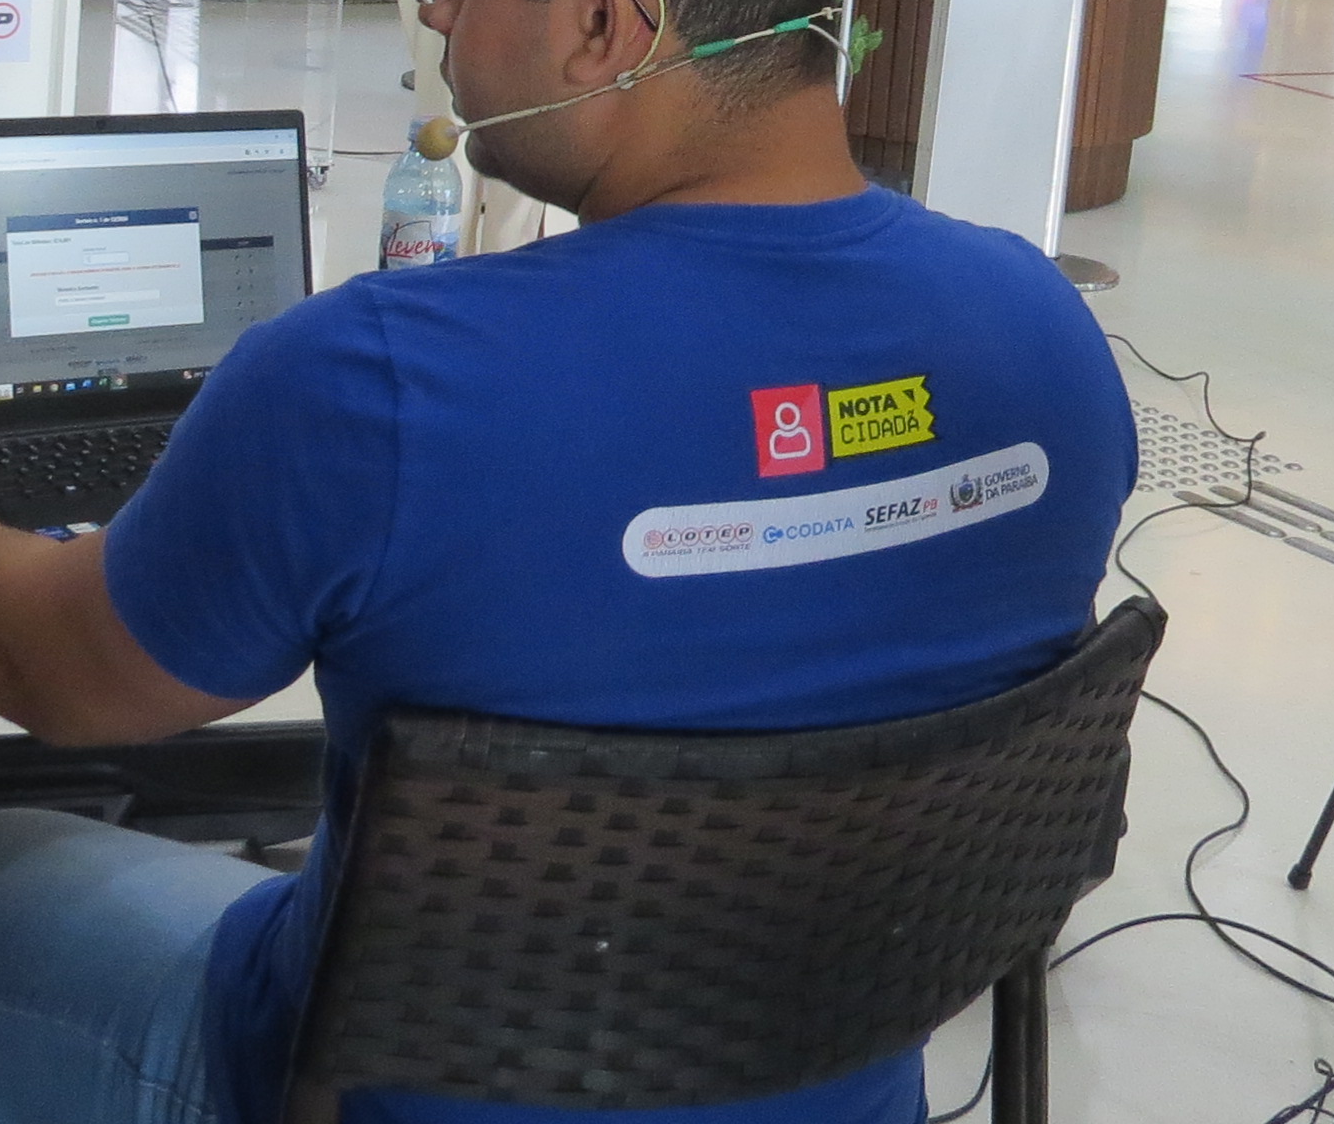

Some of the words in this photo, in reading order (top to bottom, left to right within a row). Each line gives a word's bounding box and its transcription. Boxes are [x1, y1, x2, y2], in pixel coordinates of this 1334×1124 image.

[838, 393, 899, 419] NOTA
[840, 409, 920, 445] CIDADÃ
[983, 462, 1031, 487] GOVERNO
[985, 488, 1000, 501] DA
[864, 496, 923, 527] SEFAZ
[922, 498, 939, 514] PB
[666, 525, 751, 544] LOTEP
[785, 516, 855, 540] CODATA
